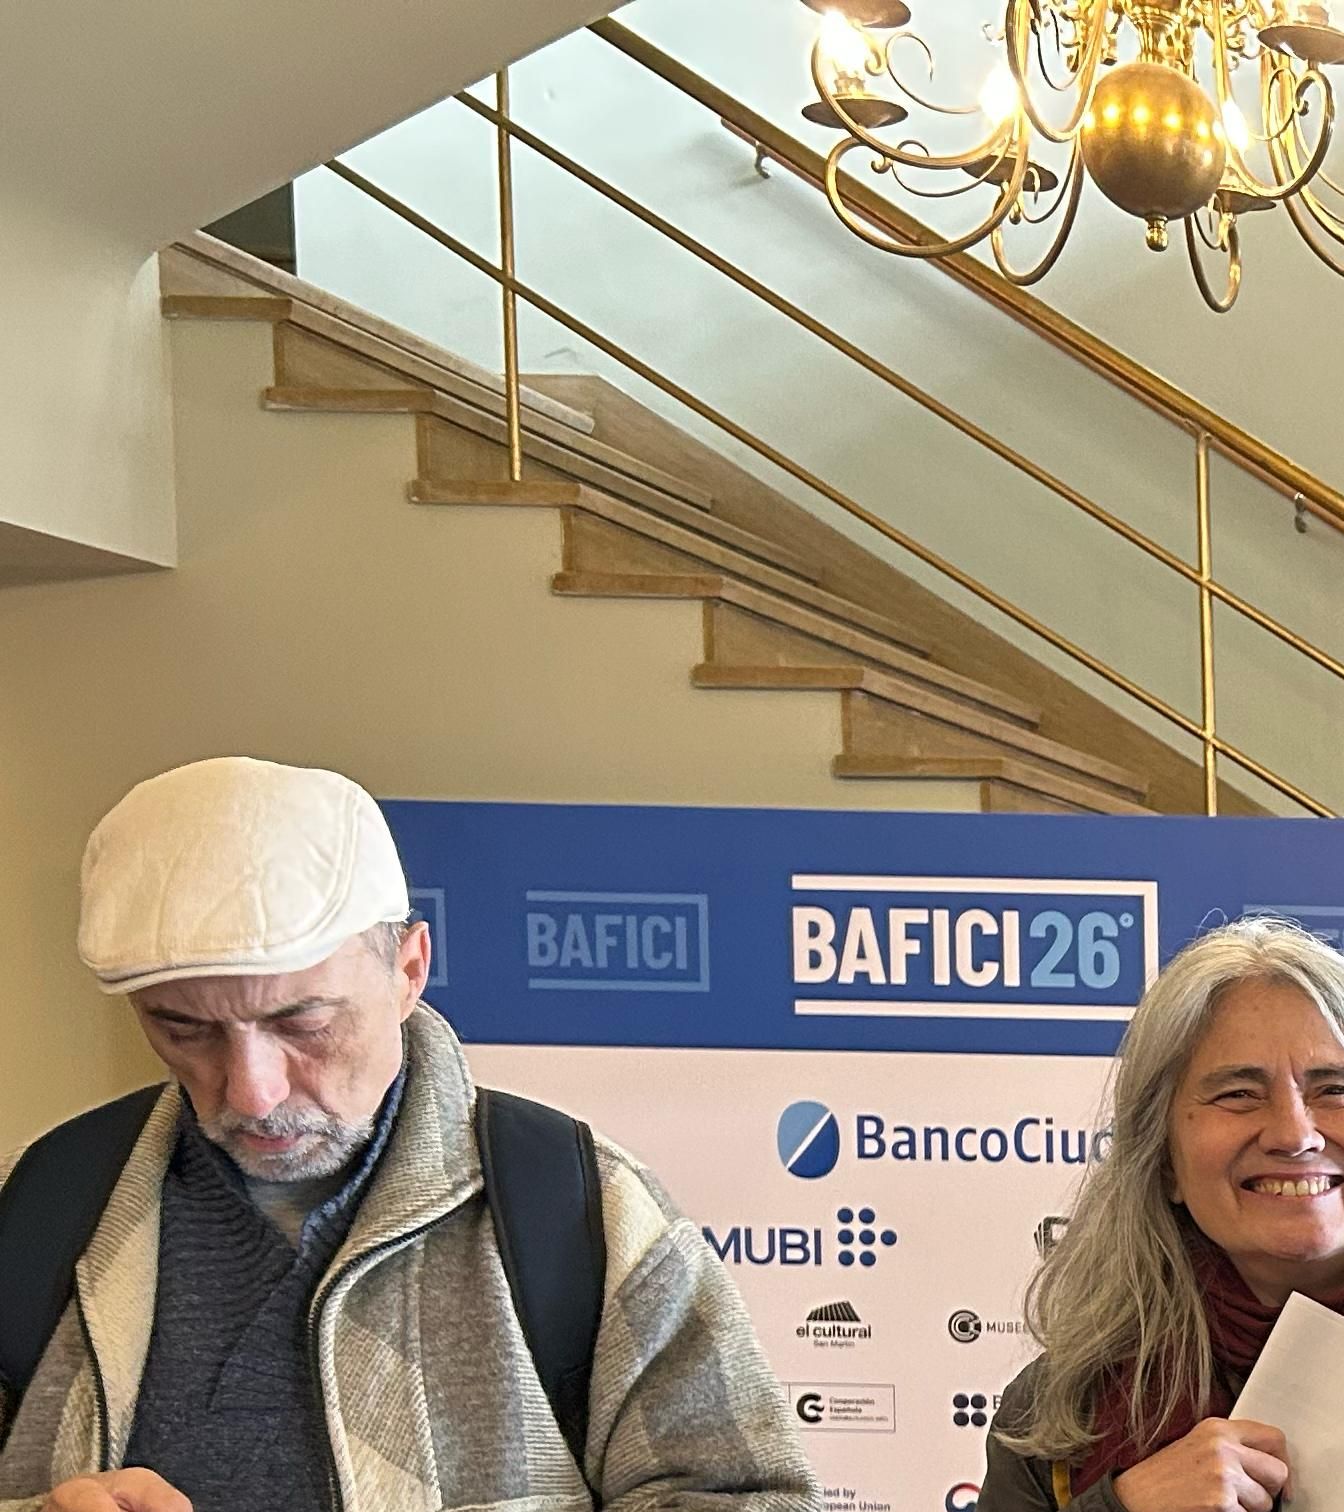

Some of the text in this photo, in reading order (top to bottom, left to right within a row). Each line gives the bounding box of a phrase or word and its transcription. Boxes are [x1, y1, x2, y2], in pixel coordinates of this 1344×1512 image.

[527, 913, 687, 970] BAFICI
[702, 1227, 822, 1266] MUBI
[796, 1323, 872, 1338] el cultural
[843, 1487, 856, 1499] by
[859, 1501, 891, 1512] Union
